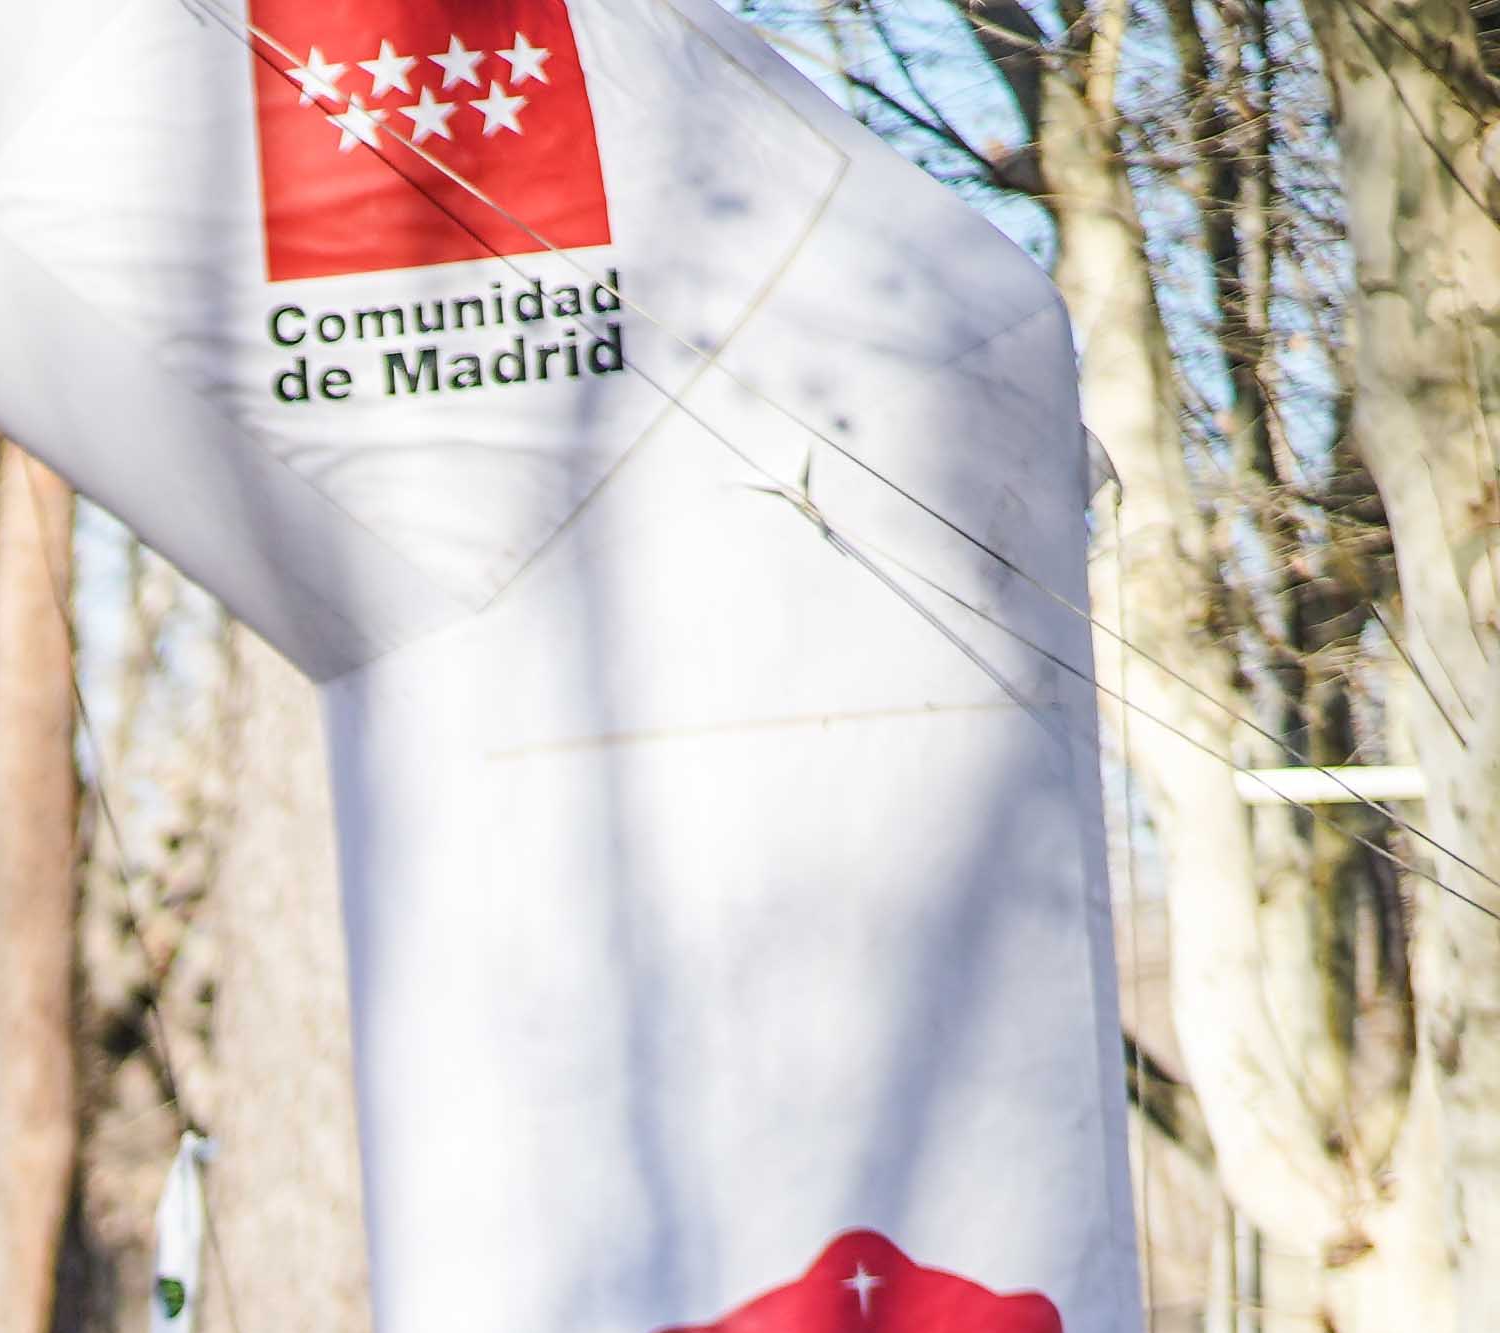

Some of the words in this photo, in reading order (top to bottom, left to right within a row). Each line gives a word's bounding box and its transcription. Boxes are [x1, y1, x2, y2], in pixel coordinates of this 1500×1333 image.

[269, 268, 622, 347] Comunidad
[274, 355, 352, 402] de
[383, 322, 625, 396] Madrid
